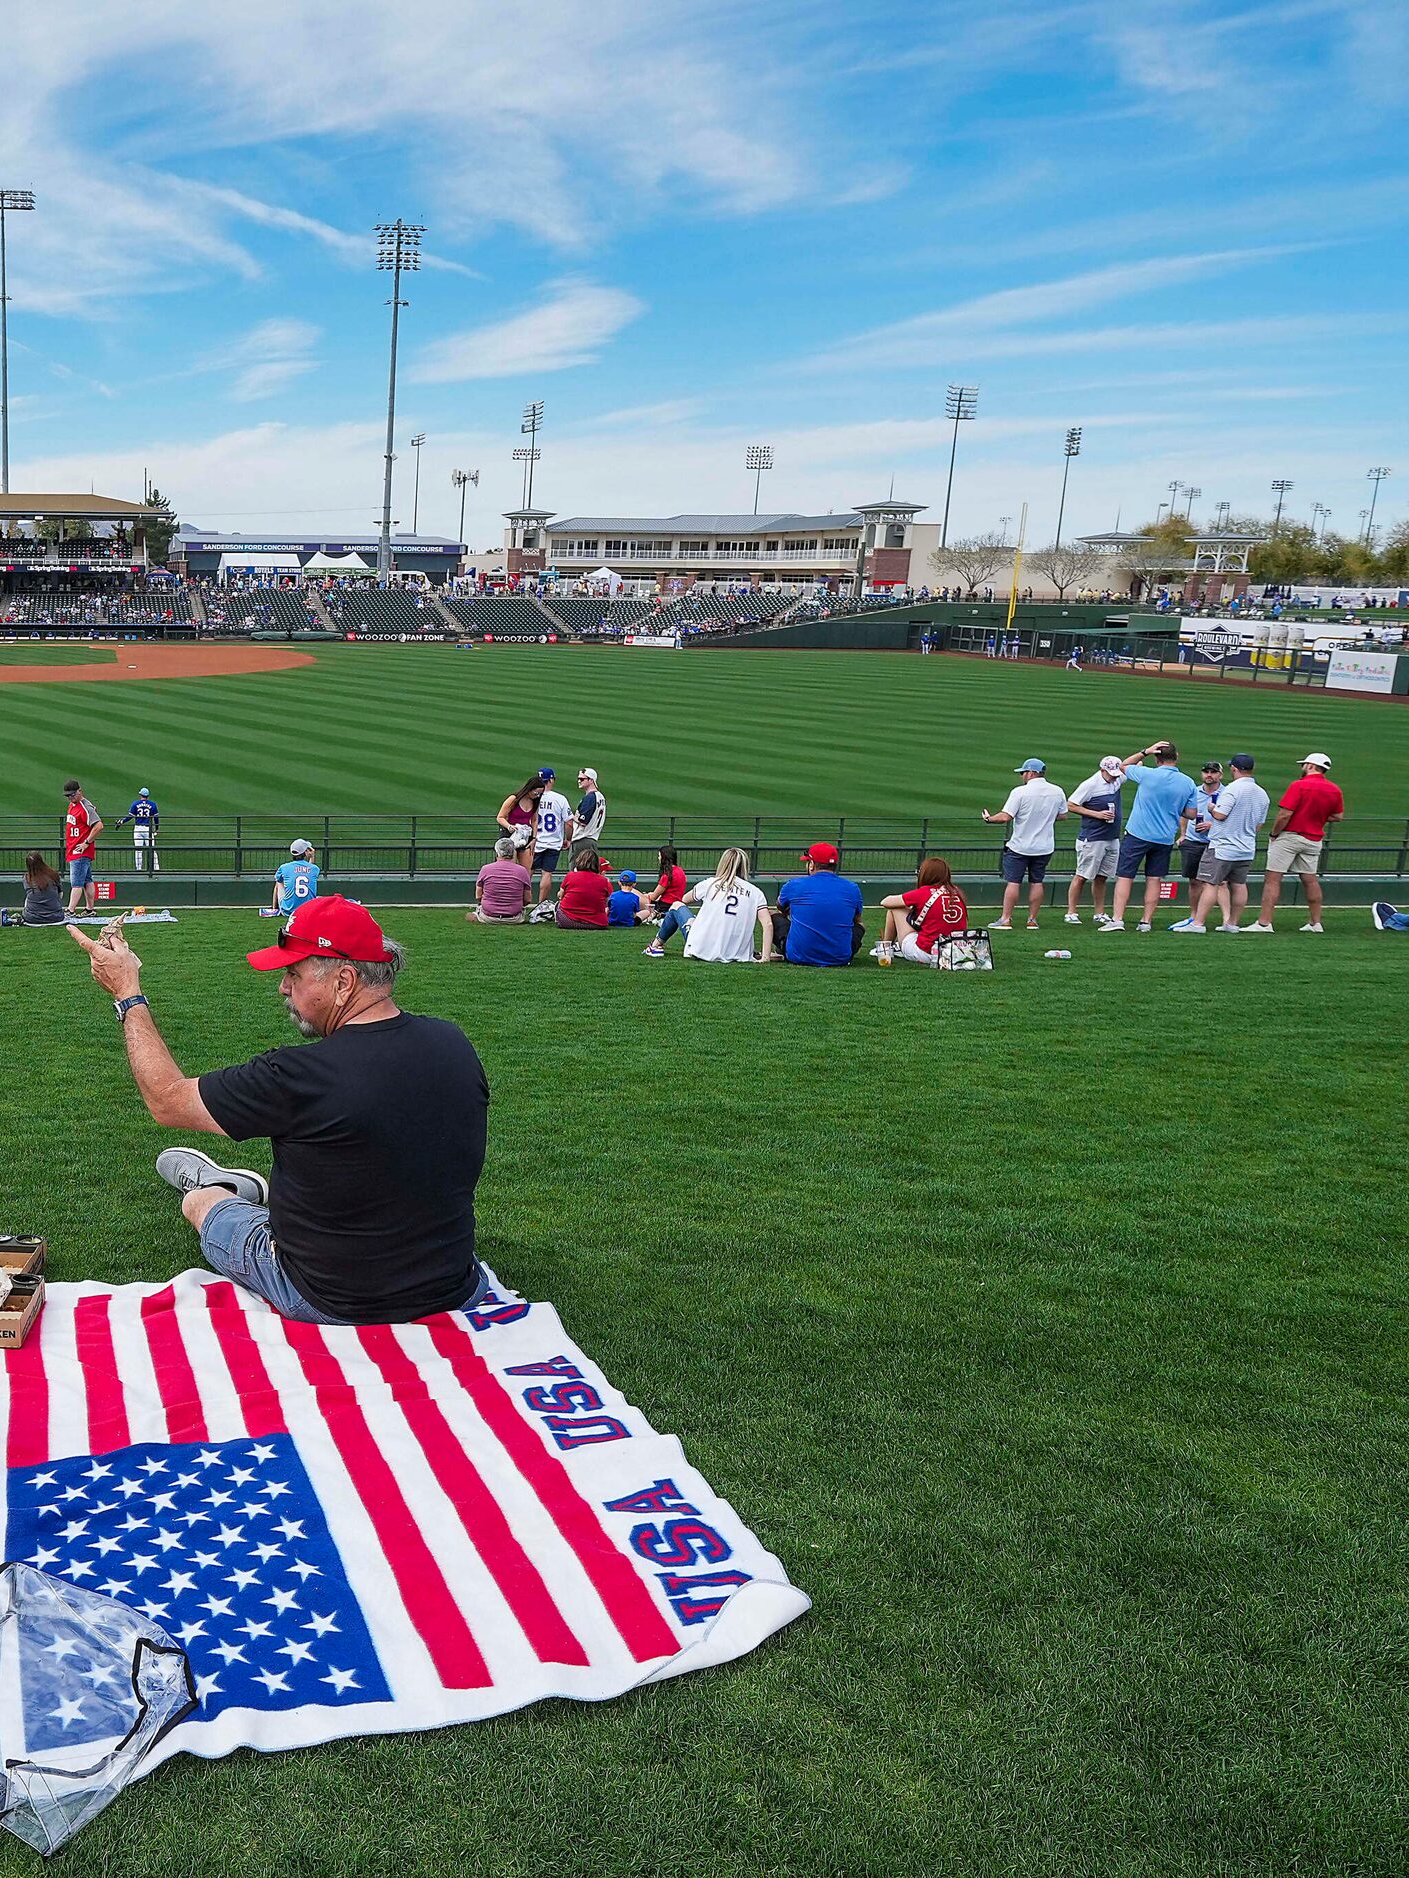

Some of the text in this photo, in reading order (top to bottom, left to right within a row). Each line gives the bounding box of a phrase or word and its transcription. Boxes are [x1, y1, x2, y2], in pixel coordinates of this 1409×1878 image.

[202, 543, 243, 551] SANDERSON
[263, 544, 304, 552] CONCOURSE
[355, 633, 396, 642] WOOZOO
[494, 635, 535, 643] WOOZOO
[539, 802, 553, 810] EIM
[137, 808, 150, 817] 33
[70, 827, 80, 837] 18
[294, 866, 311, 874] JUNG
[295, 875, 310, 898] 6
[725, 895, 739, 916] 2
[942, 895, 963, 924] 5
[502, 1355, 633, 1451] USA
[601, 1477, 753, 1627] USA
